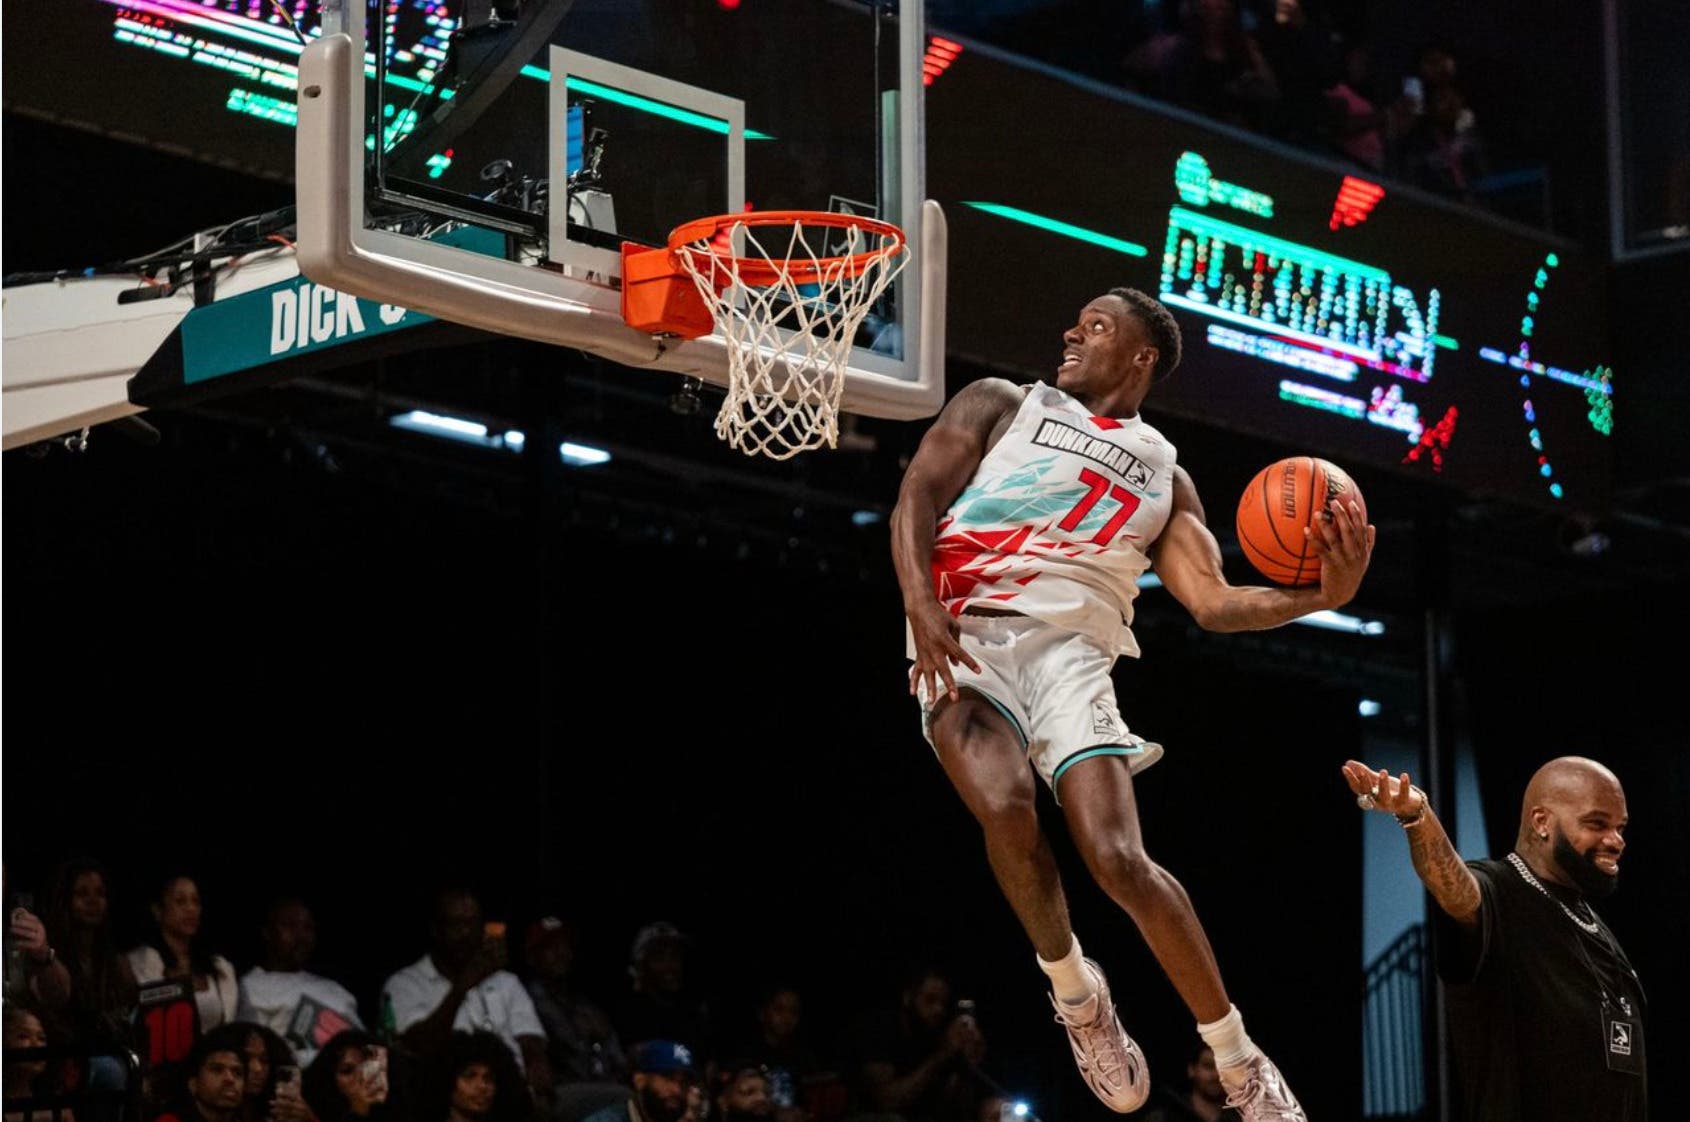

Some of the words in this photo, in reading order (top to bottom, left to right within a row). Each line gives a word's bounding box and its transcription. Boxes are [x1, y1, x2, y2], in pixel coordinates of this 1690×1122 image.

[270, 283, 406, 356] DICK
[1034, 421, 1133, 476] DUNKMAN
[1057, 467, 1142, 547] 77
